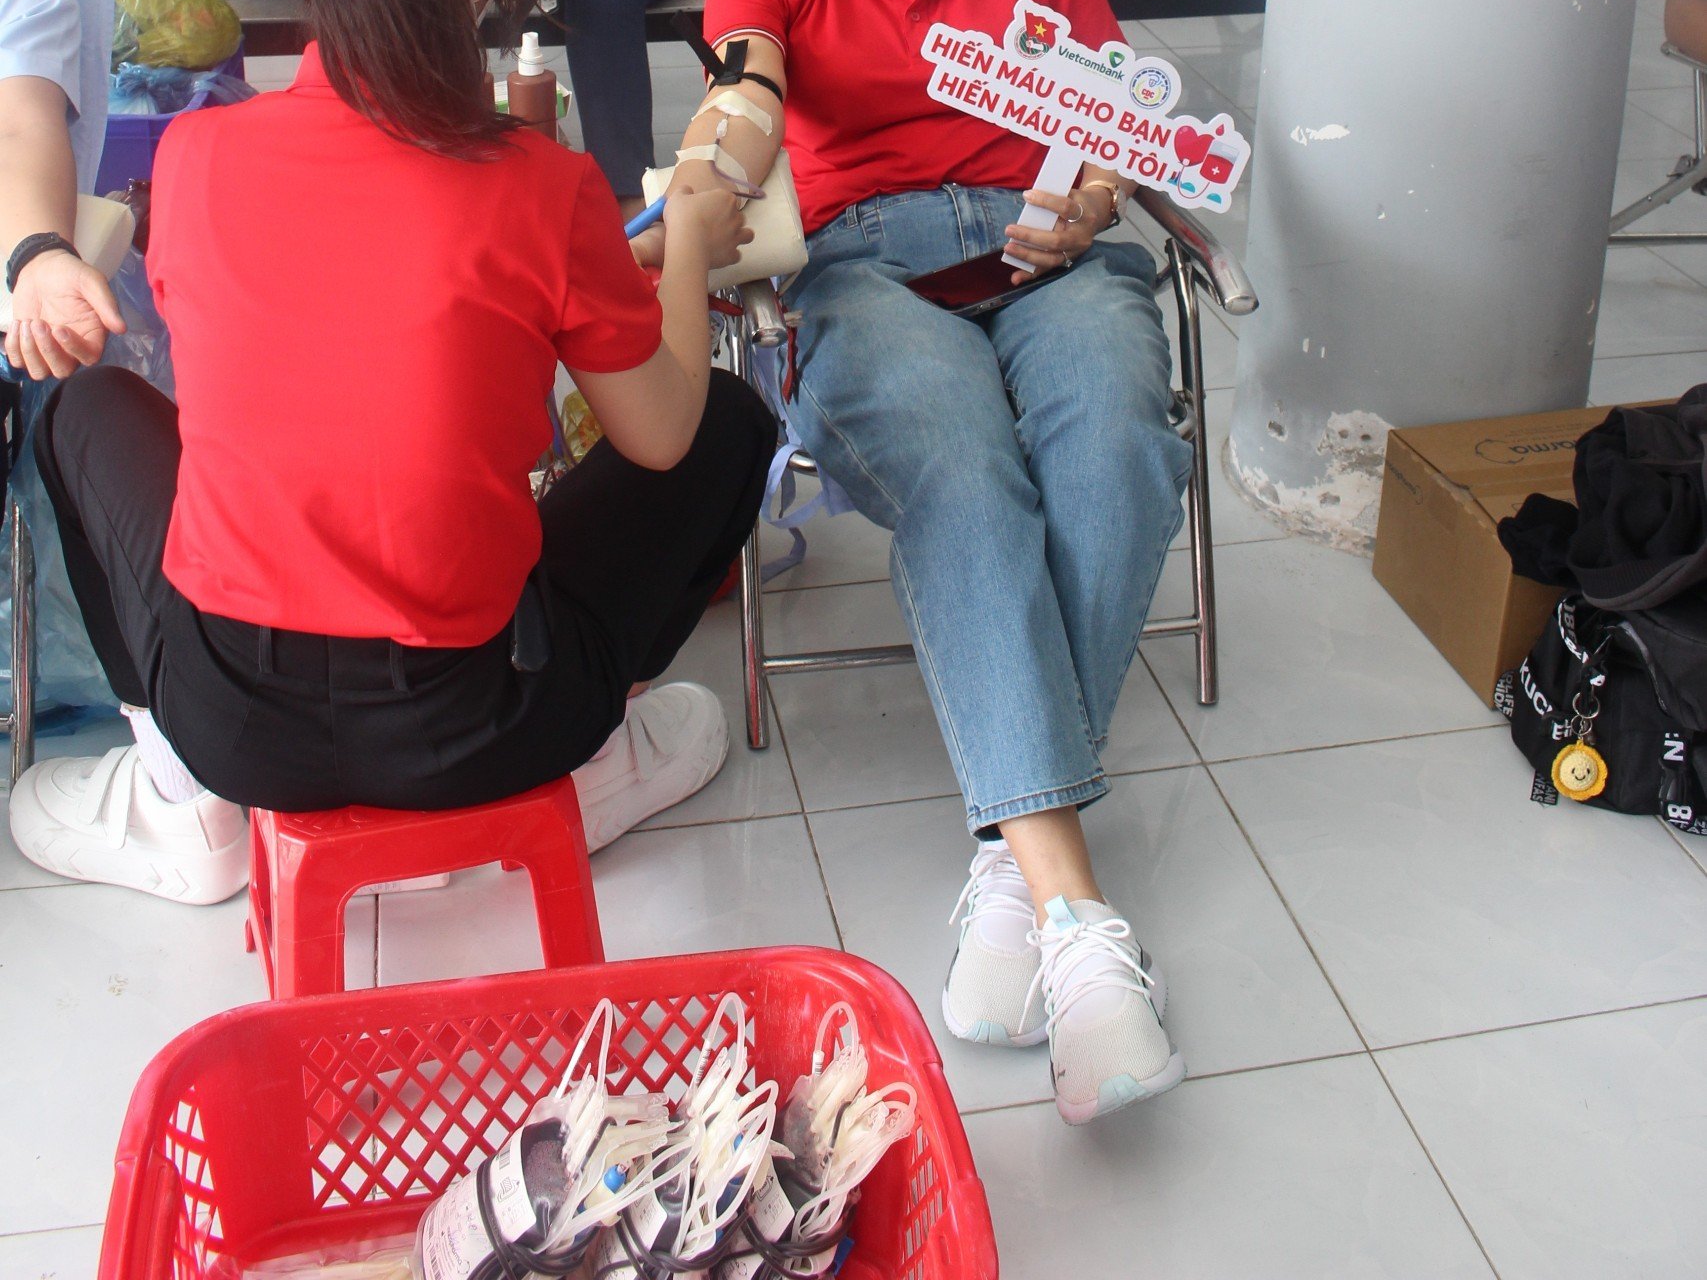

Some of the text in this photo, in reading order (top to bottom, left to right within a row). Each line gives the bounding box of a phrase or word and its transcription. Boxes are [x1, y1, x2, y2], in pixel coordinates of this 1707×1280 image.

[1058, 45, 1125, 81] Vietcombank
[931, 33, 994, 74] HIẾN
[996, 60, 1056, 98] MÁU
[1058, 87, 1115, 123] CHO
[1117, 111, 1172, 148] BẠN
[1141, 88, 1155, 98] CDC
[937, 72, 1001, 113] HIẾN
[1002, 99, 1062, 136] MÁU
[1064, 125, 1120, 161] CHO
[1508, 440, 1578, 455] arma
